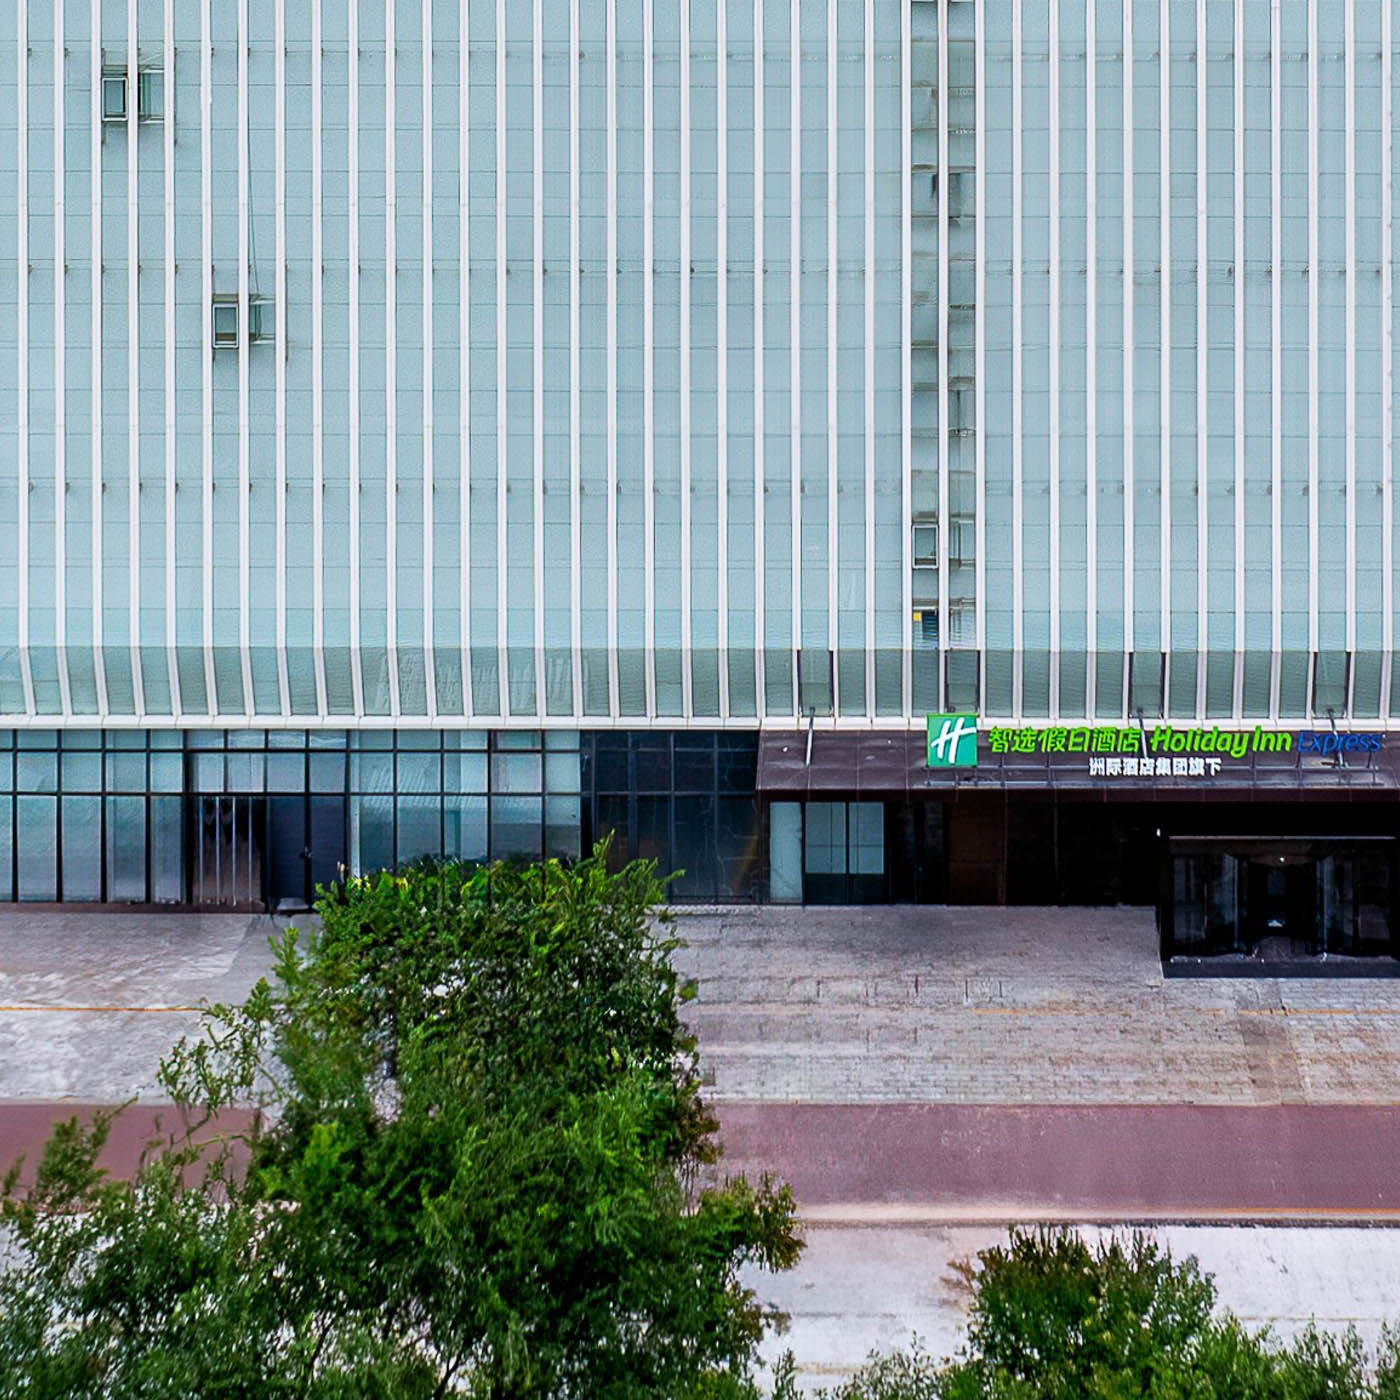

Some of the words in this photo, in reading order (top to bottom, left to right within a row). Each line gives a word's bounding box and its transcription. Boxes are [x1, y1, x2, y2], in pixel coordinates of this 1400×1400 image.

[988, 725, 1142, 753] 智选假日酒店
[1151, 725, 1250, 758] Holiday
[1252, 725, 1292, 752] Inn
[1297, 729, 1383, 756] Express
[1089, 756, 1222, 777] 洲际酒店集团旗下
